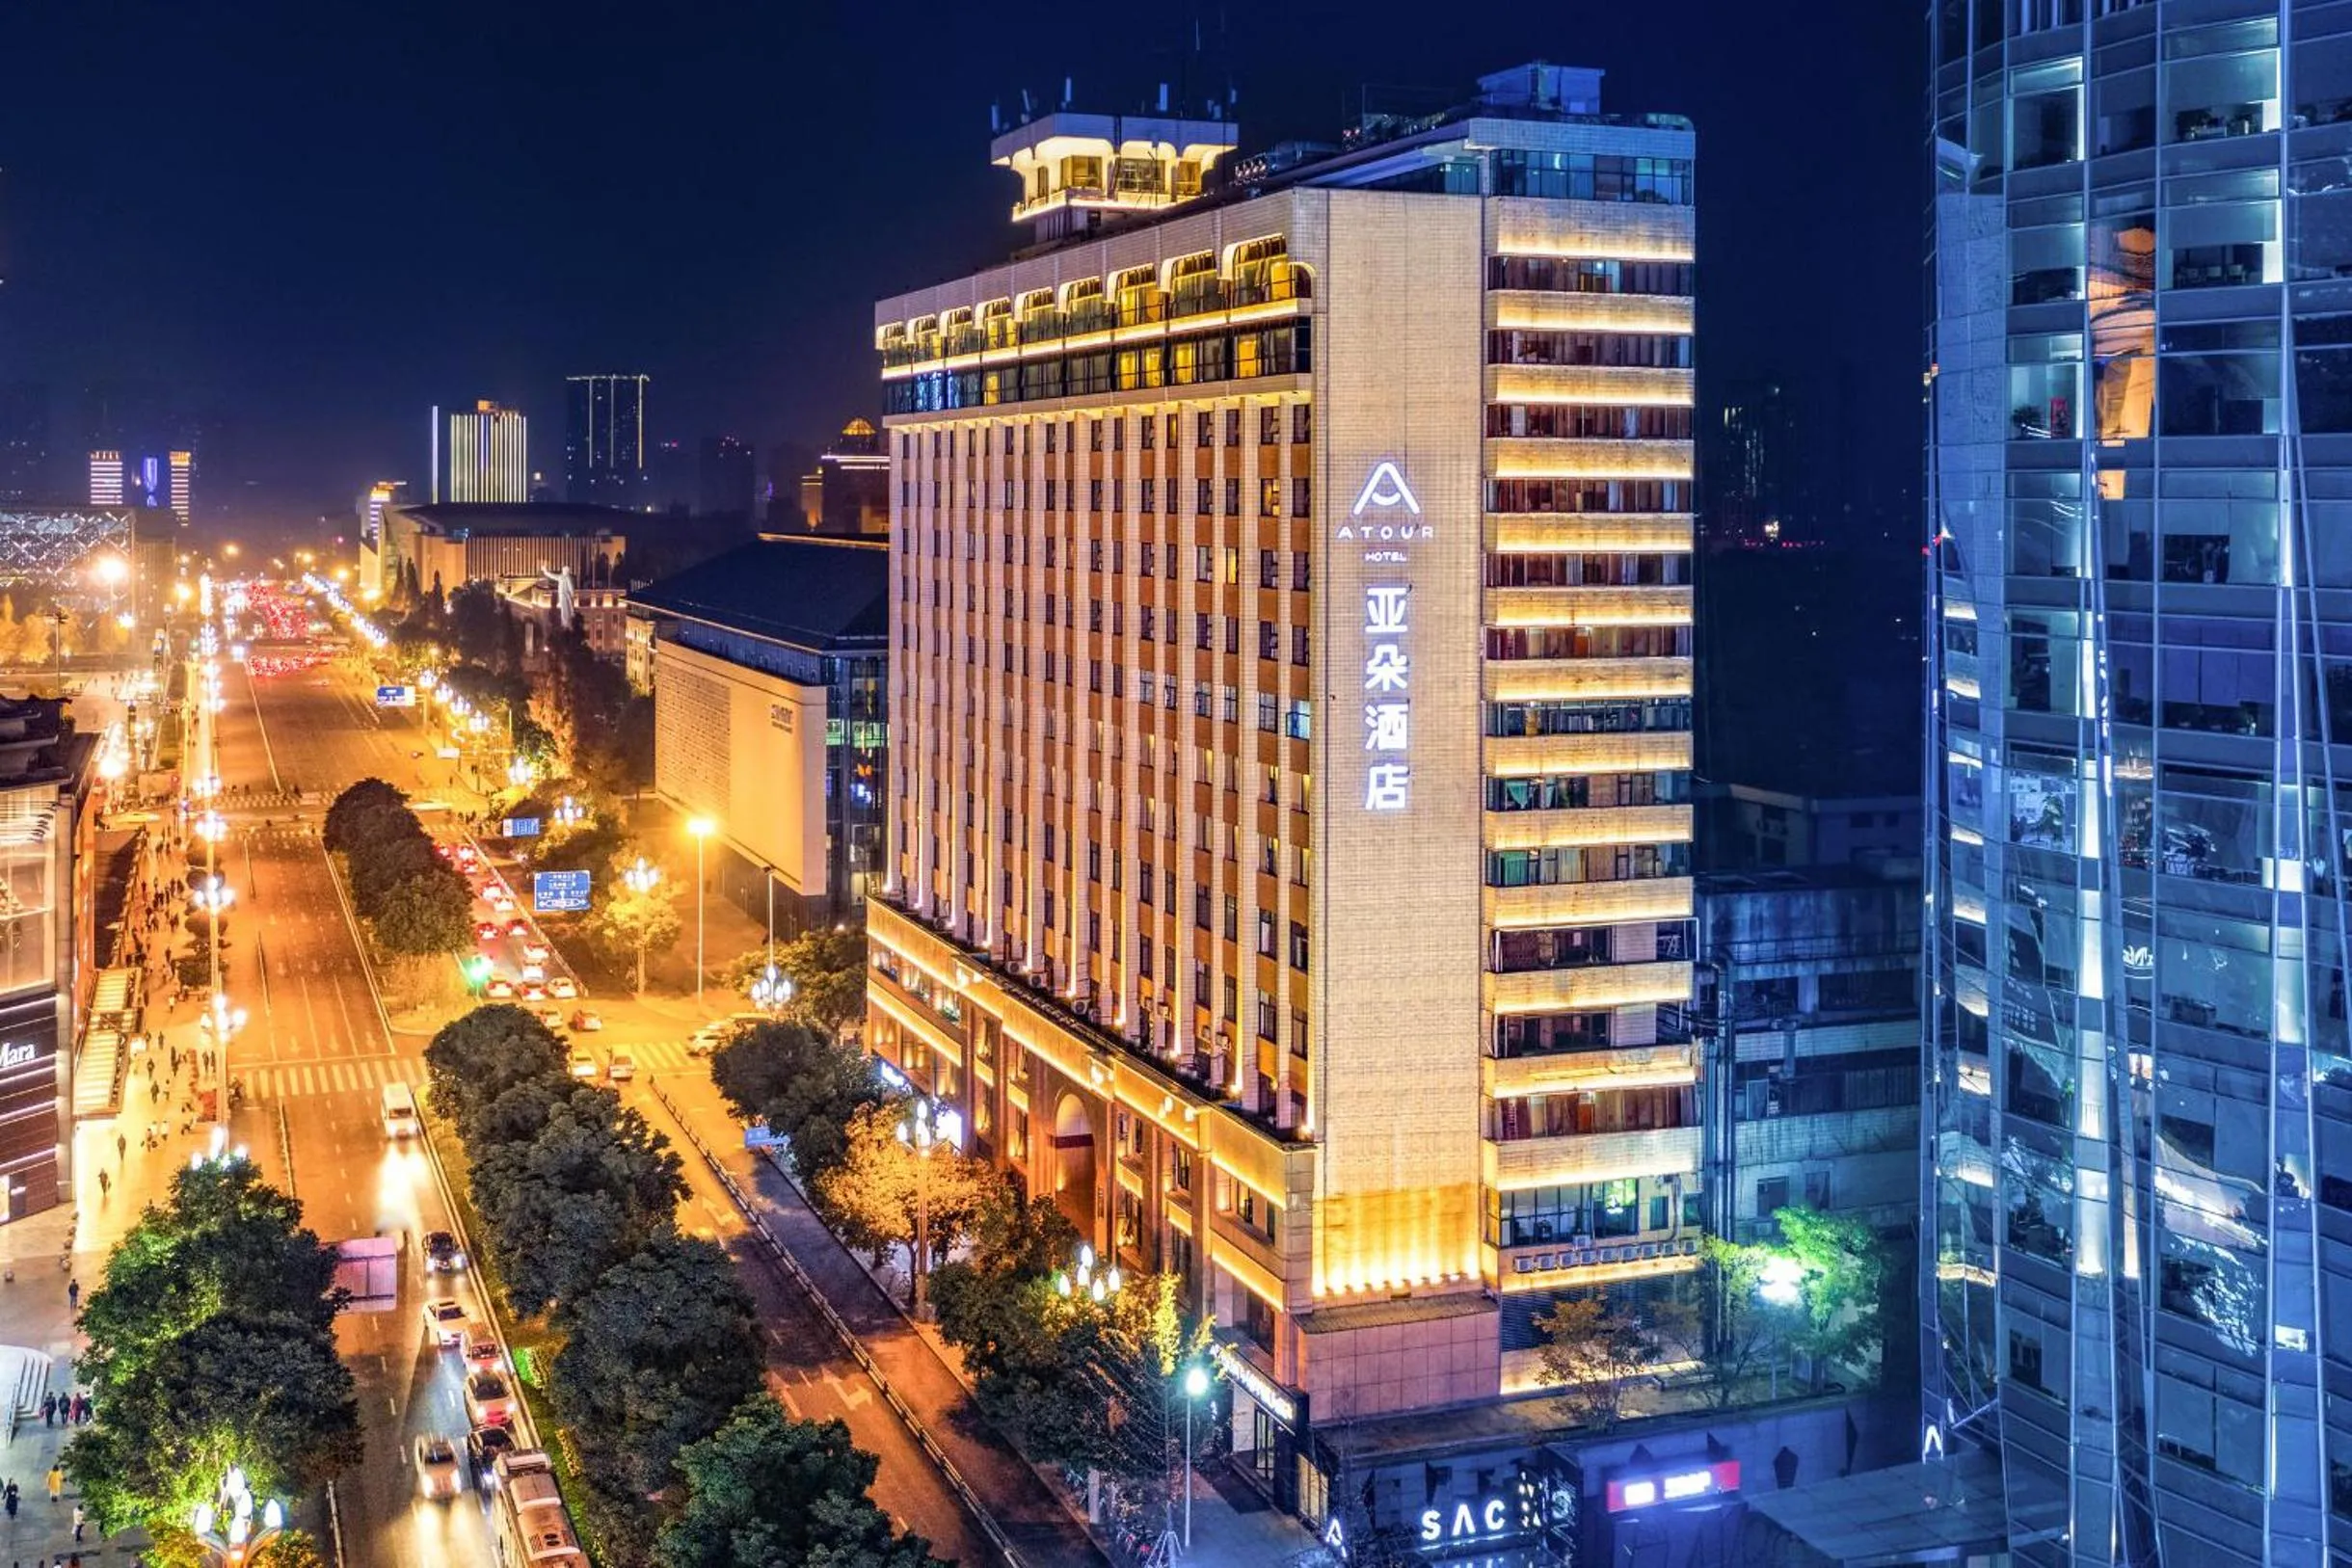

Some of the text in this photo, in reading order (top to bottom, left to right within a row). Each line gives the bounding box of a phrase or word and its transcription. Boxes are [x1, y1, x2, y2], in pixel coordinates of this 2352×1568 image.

[1338, 526, 1434, 540] ATOUR
[1364, 551, 1407, 562] HOTEL
[1364, 587, 1409, 811] 亚朵酒店
